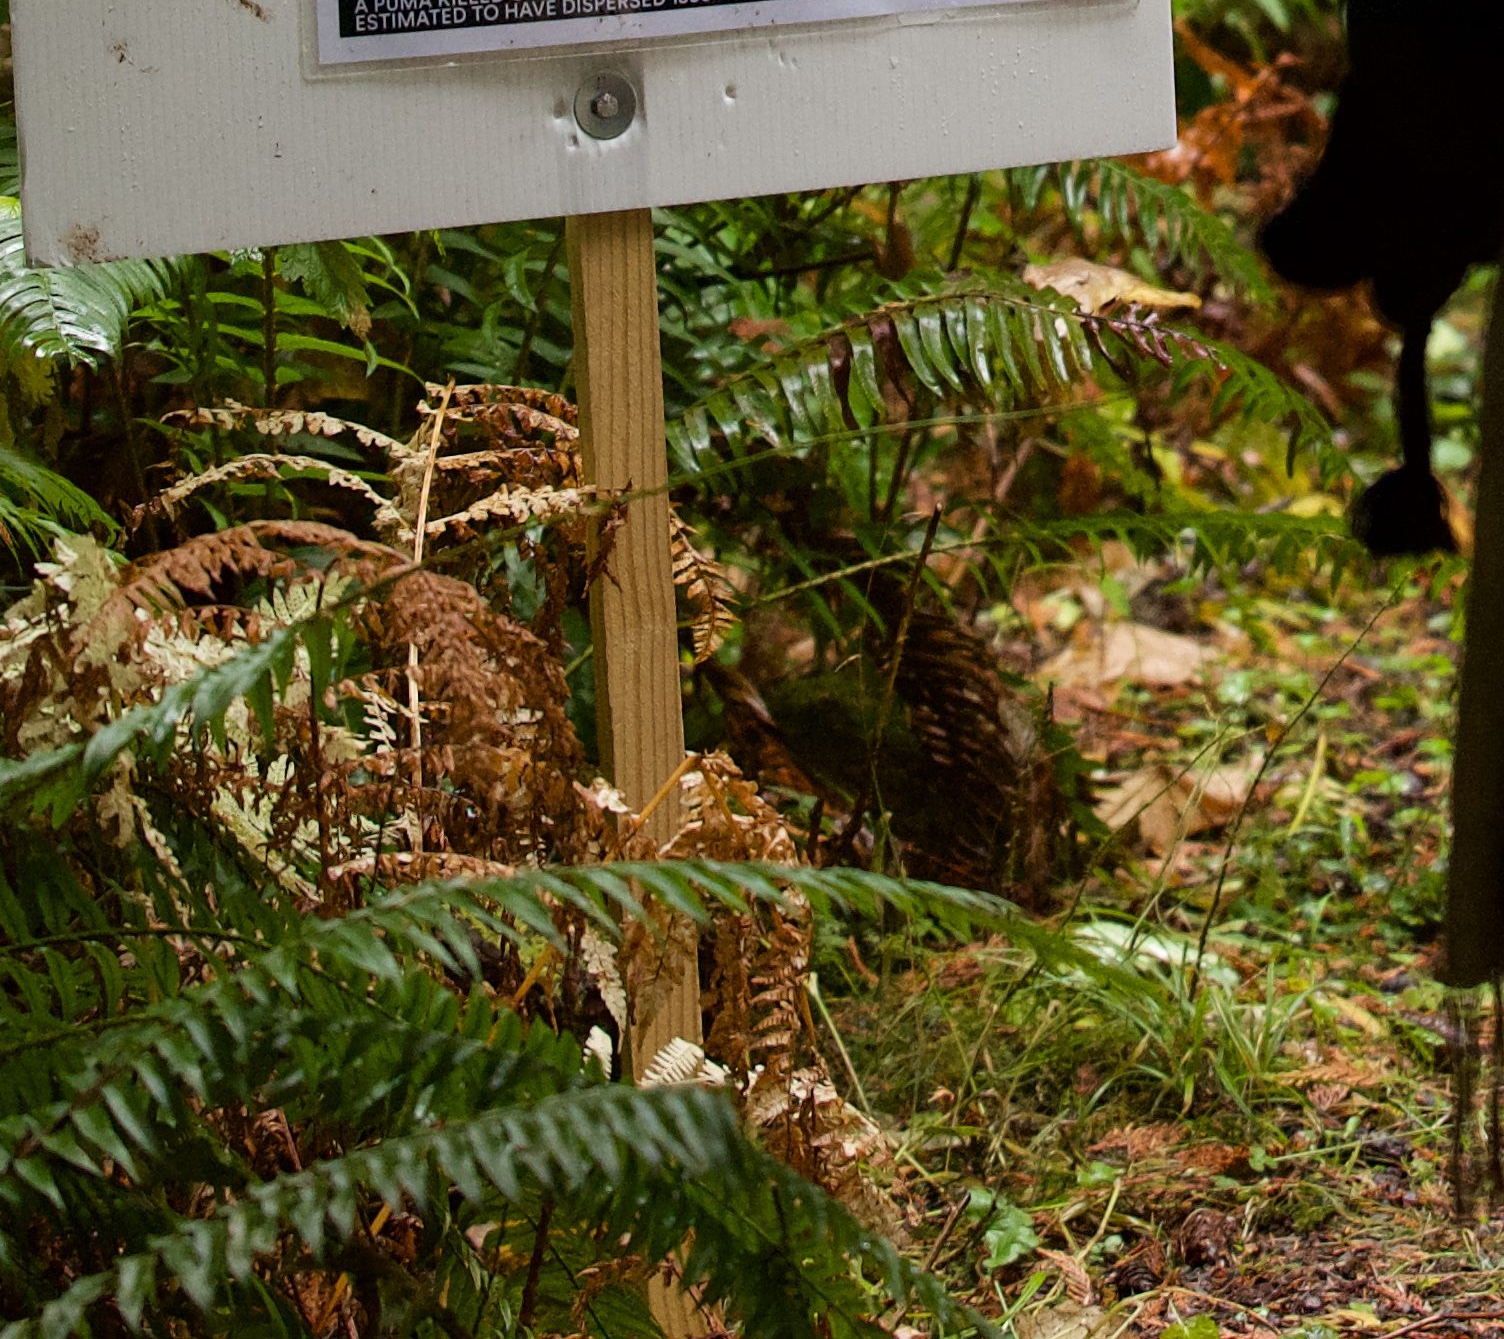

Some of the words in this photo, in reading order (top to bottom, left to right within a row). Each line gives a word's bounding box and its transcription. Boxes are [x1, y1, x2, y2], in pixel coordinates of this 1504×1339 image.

[355, 7, 467, 32] ESTIMATED
[472, 4, 499, 22] TO
[505, 0, 556, 19] HAVE
